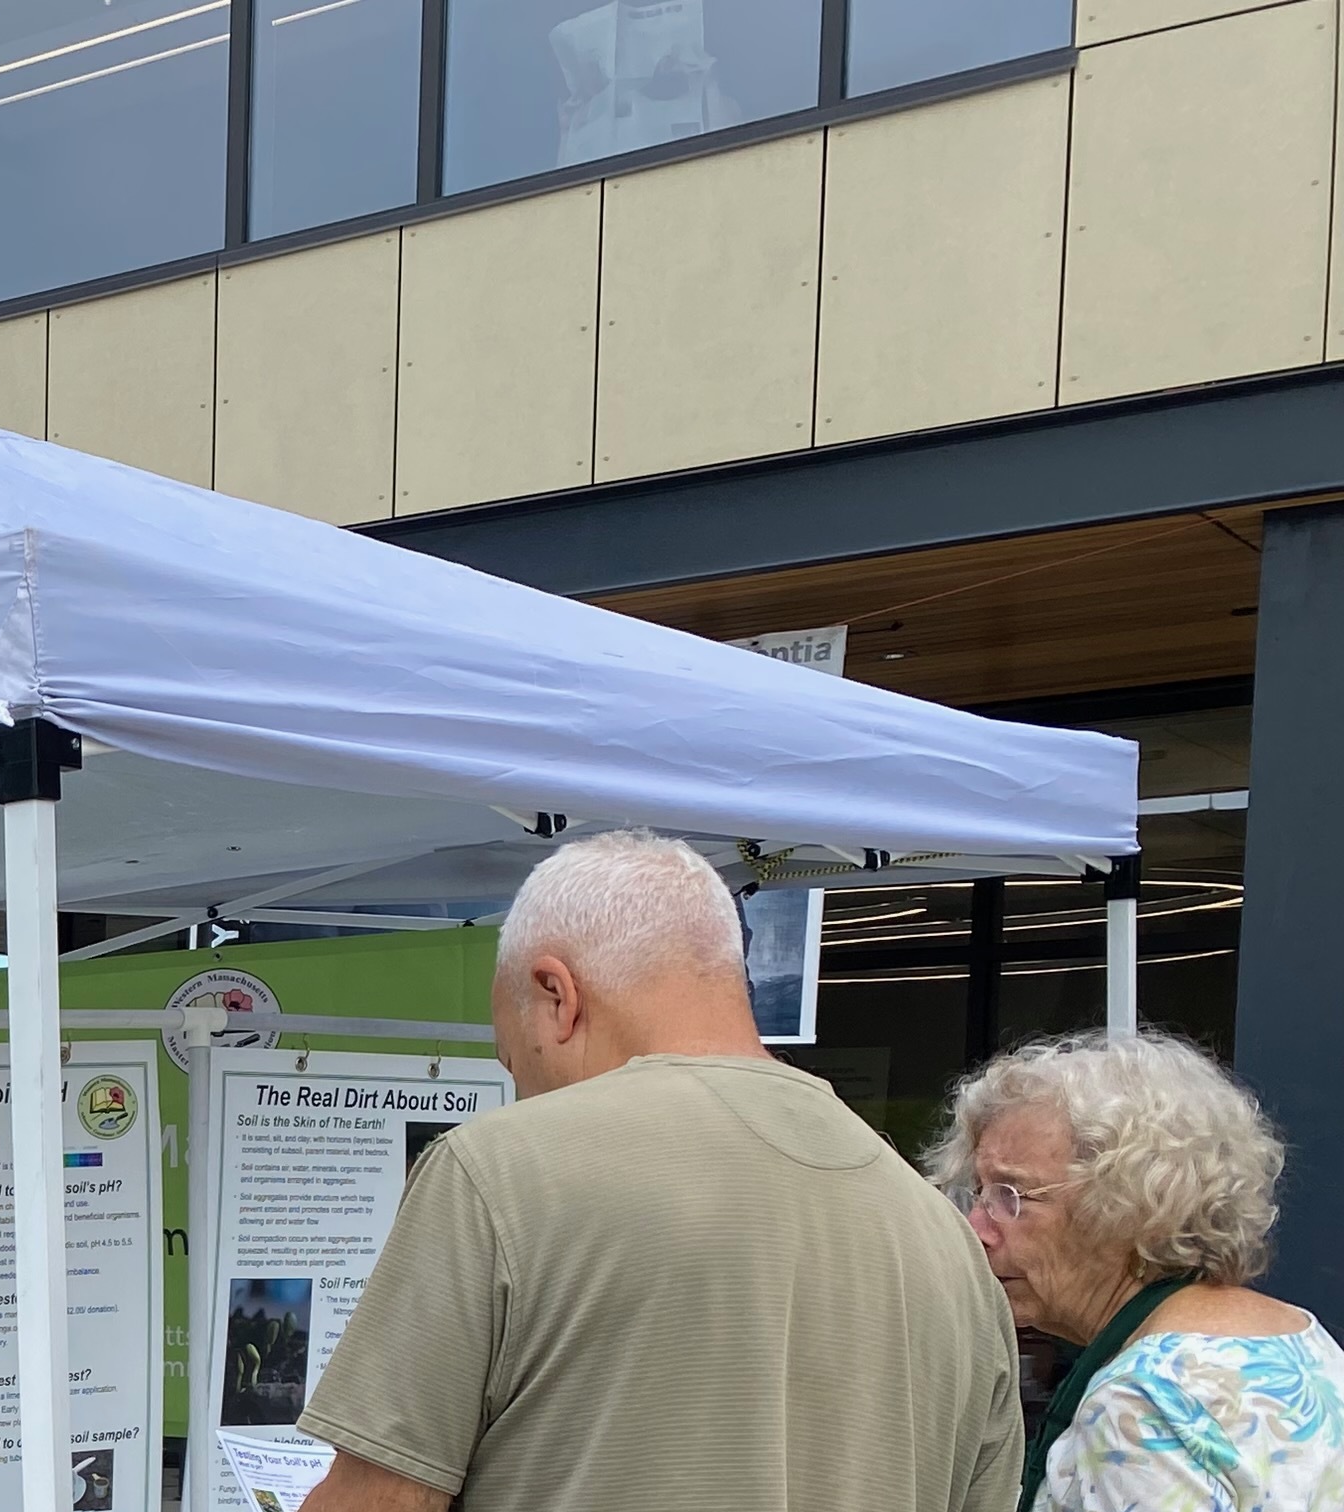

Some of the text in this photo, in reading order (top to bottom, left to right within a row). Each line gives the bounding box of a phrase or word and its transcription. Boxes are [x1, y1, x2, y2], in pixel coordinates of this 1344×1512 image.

[757, 636, 832, 664] ntia
[256, 1084, 478, 1113] The Real Dirt About Soil
[236, 1114, 386, 1130] Soil is the Skin of The Earth!
[64, 1179, 123, 1195] soil's pH?
[319, 1276, 369, 1290] Soil Ferti
[68, 1368, 92, 1383] est?
[2, 1437, 15, 1449] to
[70, 1426, 140, 1444] soil sample?
[233, 1448, 262, 1465] Testing
[262, 1453, 282, 1465] Your
